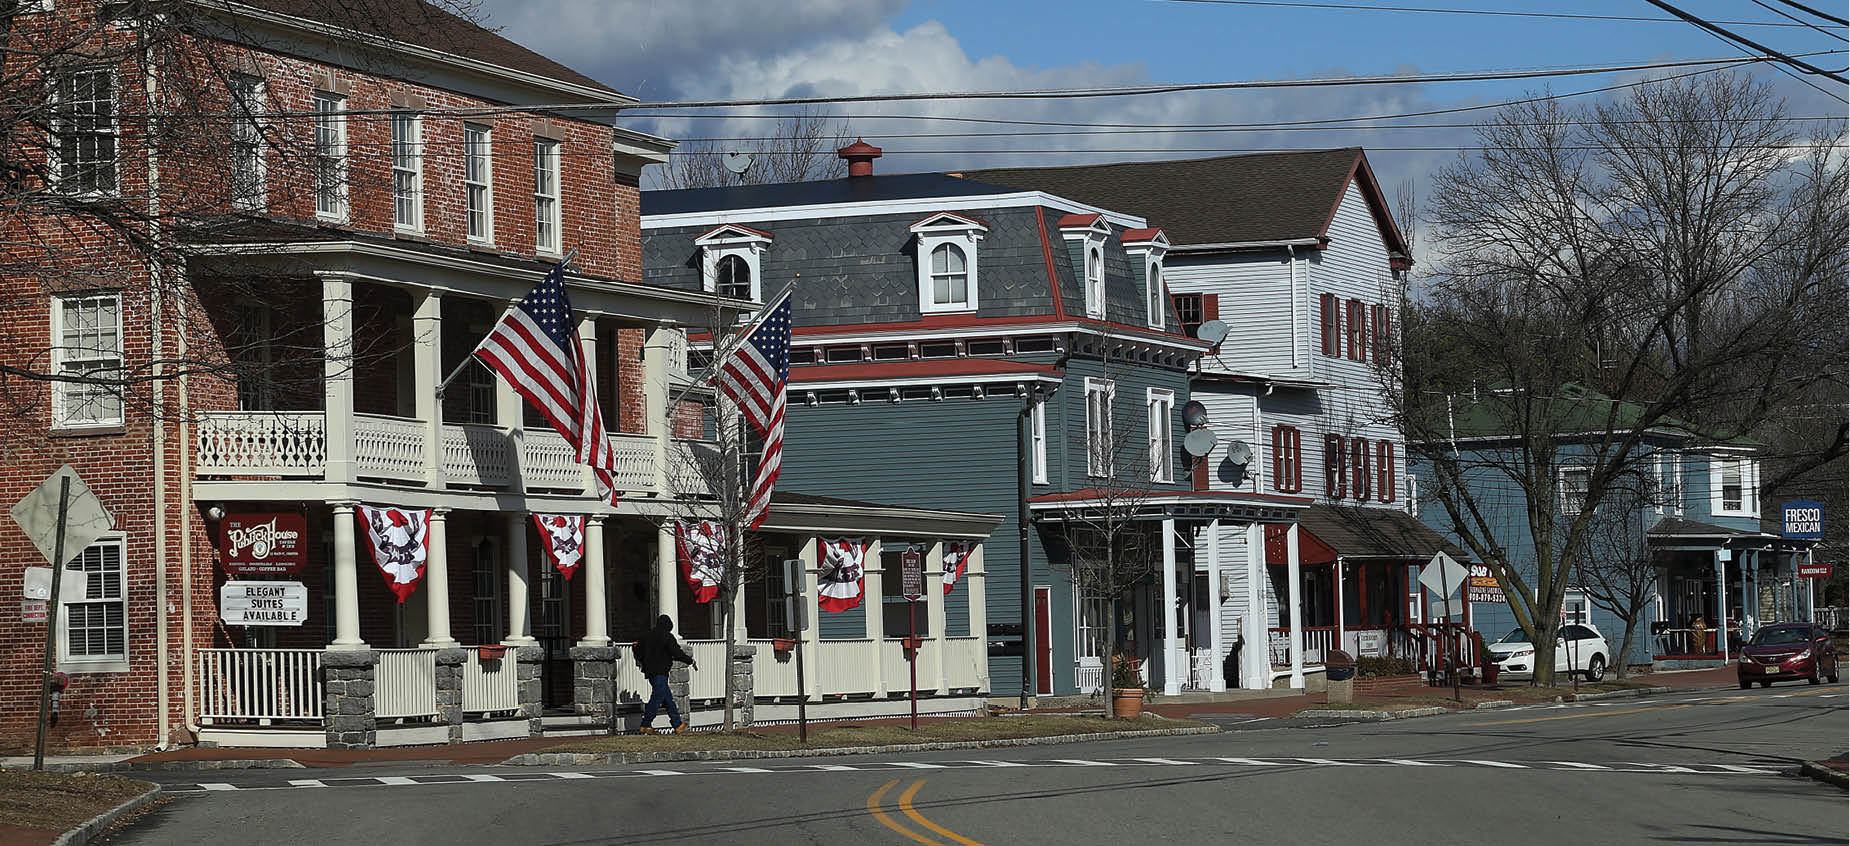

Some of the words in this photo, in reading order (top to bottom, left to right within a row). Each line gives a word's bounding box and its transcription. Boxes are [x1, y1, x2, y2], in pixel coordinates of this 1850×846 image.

[1785, 508, 1820, 521] FRESCO
[1785, 522, 1820, 533] MEXICAN
[246, 587, 285, 597] ELEGANT
[251, 600, 283, 608] SUITES
